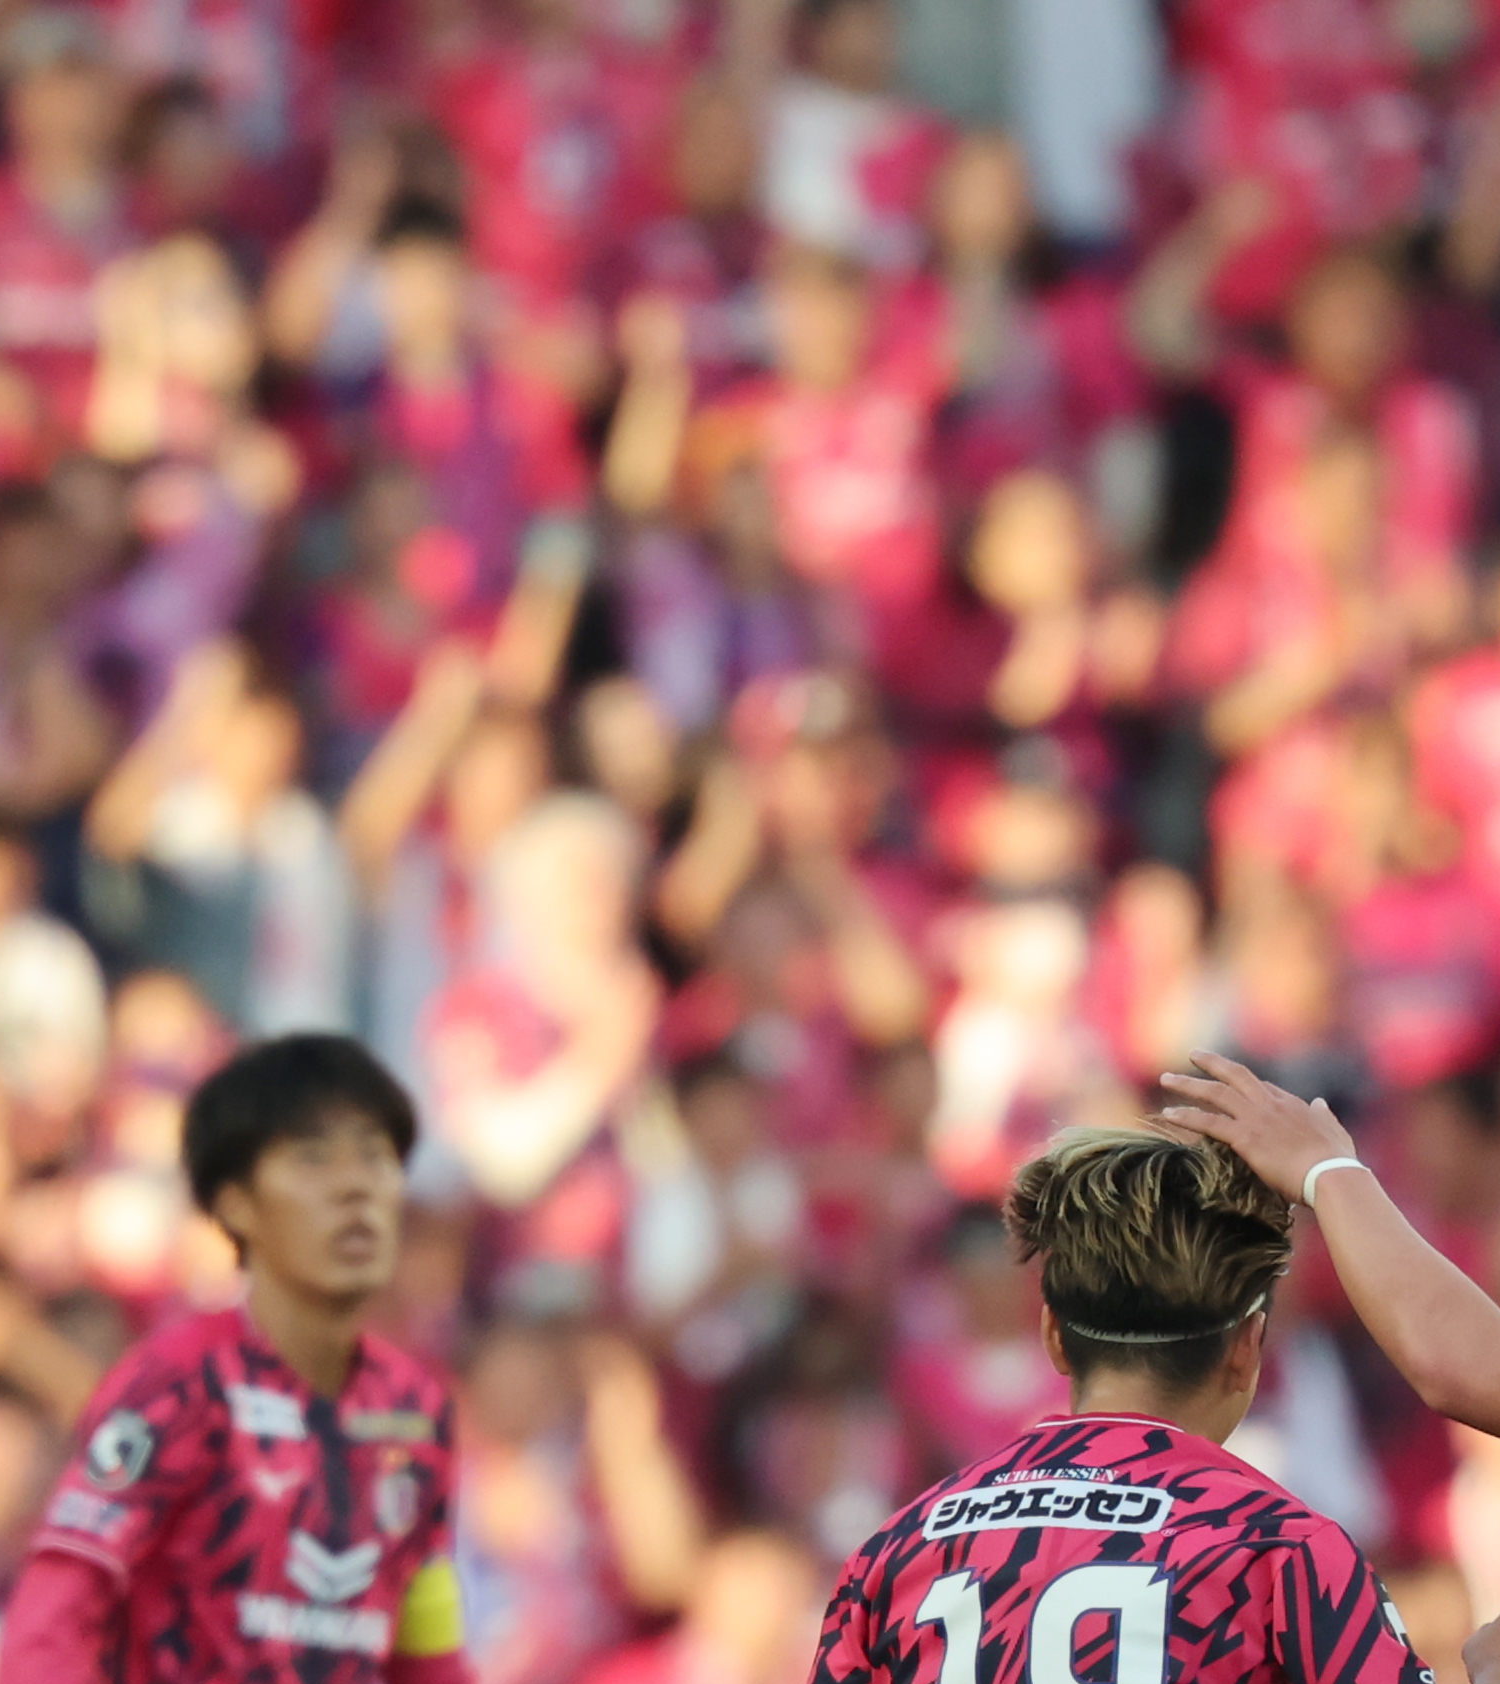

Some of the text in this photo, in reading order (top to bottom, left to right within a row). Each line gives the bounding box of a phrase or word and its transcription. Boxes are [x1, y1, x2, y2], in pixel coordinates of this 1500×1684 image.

[991, 1467, 1119, 1486] SCHAU ESSEN
[931, 1485, 1163, 1532] シャウエッセン
